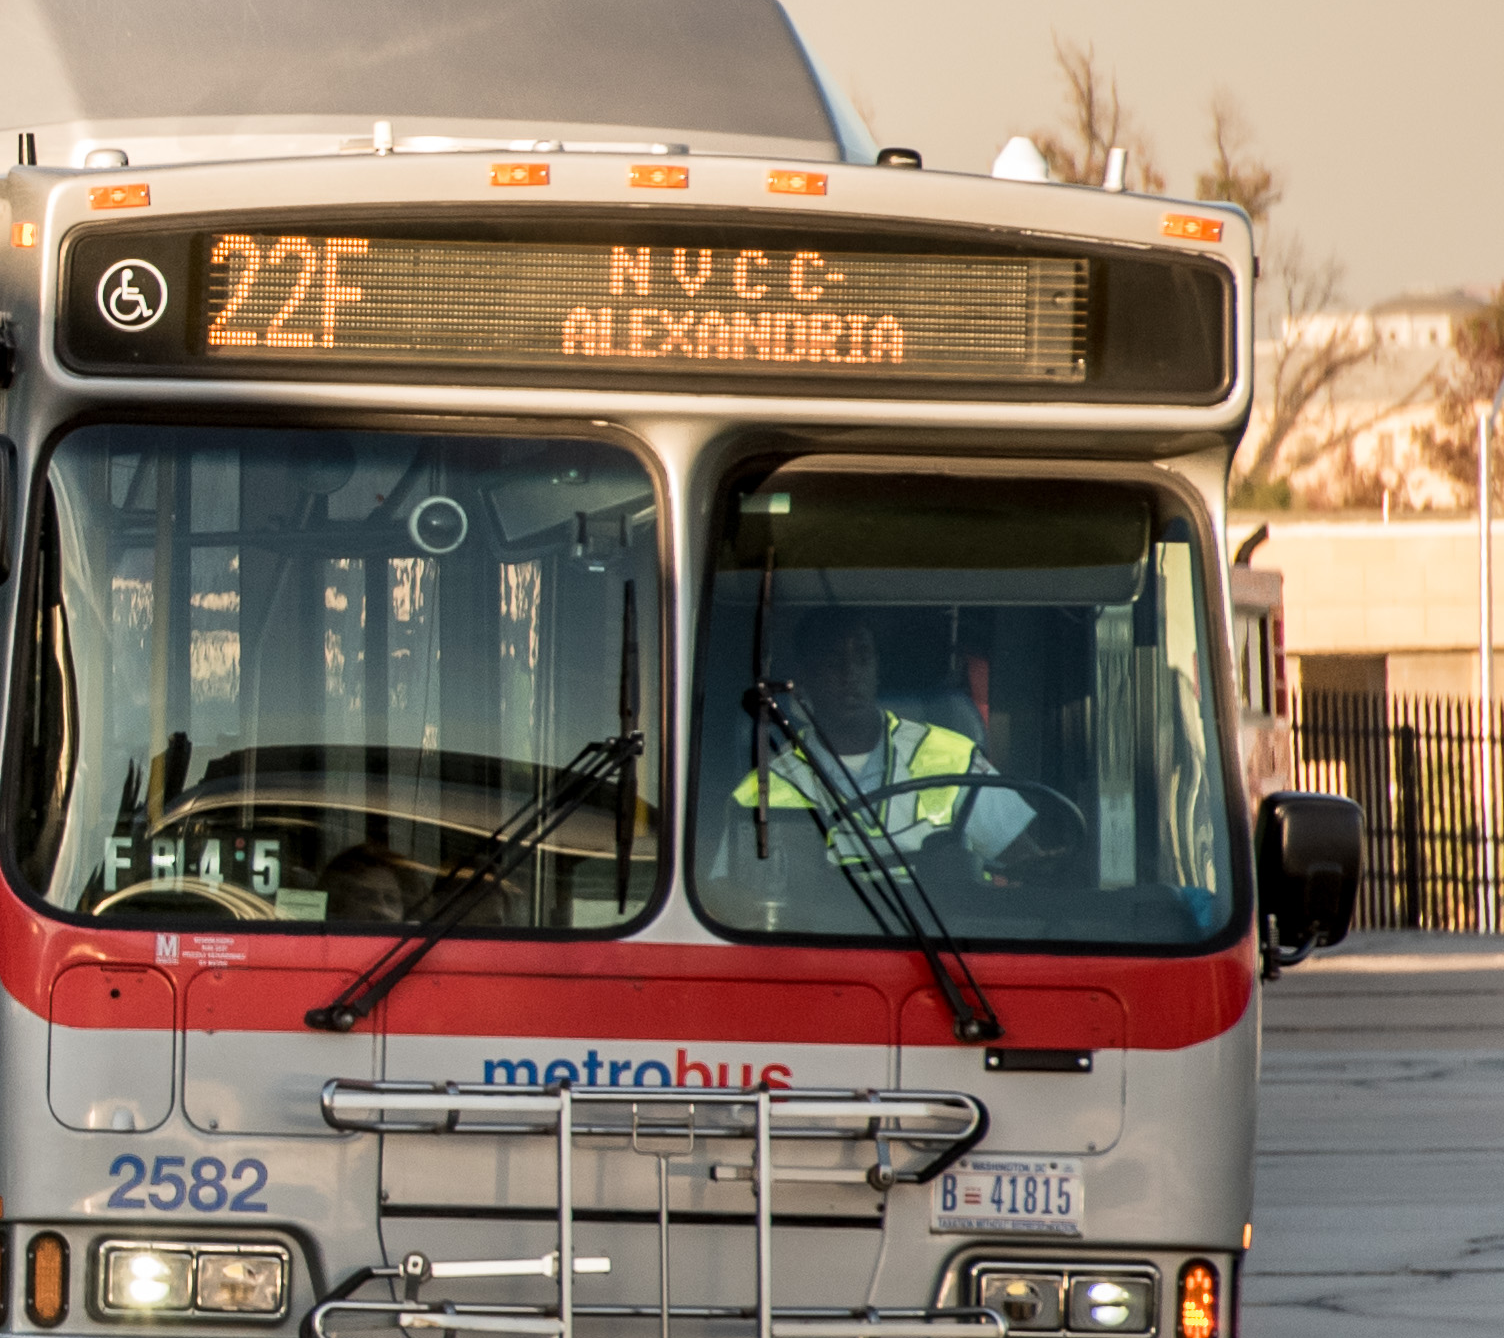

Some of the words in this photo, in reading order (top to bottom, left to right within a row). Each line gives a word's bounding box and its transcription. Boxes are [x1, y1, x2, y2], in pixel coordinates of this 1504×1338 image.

[208, 234, 369, 349] 22F
[561, 307, 905, 364] ALEXANDRIA
[483, 1048, 793, 1090] metrobus
[108, 1154, 269, 1213] 2582
[942, 1173, 957, 1212] B
[990, 1175, 1071, 1215] 41815
